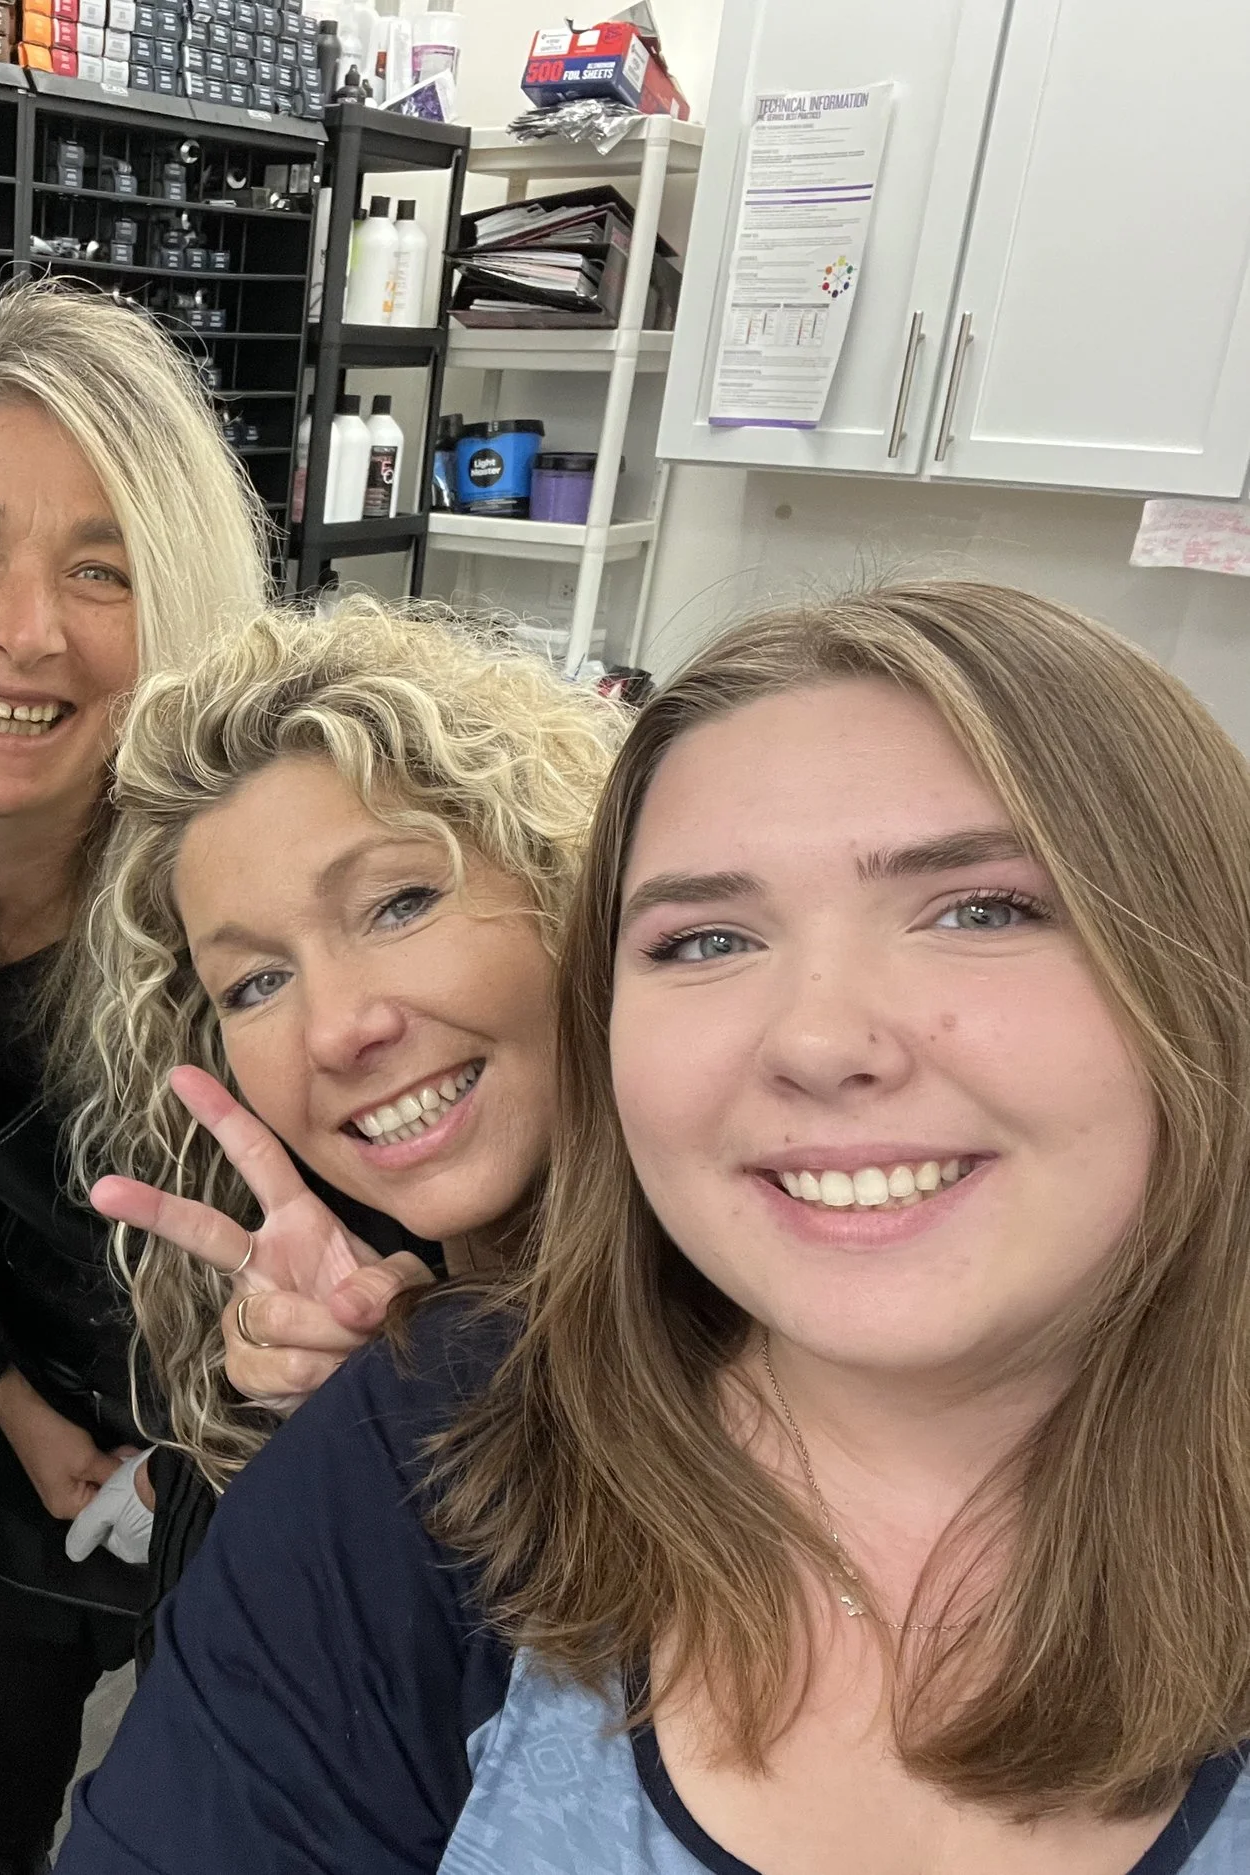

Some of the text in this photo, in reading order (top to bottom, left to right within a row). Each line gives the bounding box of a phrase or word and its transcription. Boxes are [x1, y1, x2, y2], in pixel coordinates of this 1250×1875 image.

[526, 60, 614, 83] 500 FOIL SHEETS
[759, 92, 869, 115] TECHNICAL INFORMATION
[470, 466, 501, 478] Master
[473, 458, 496, 469] Light
